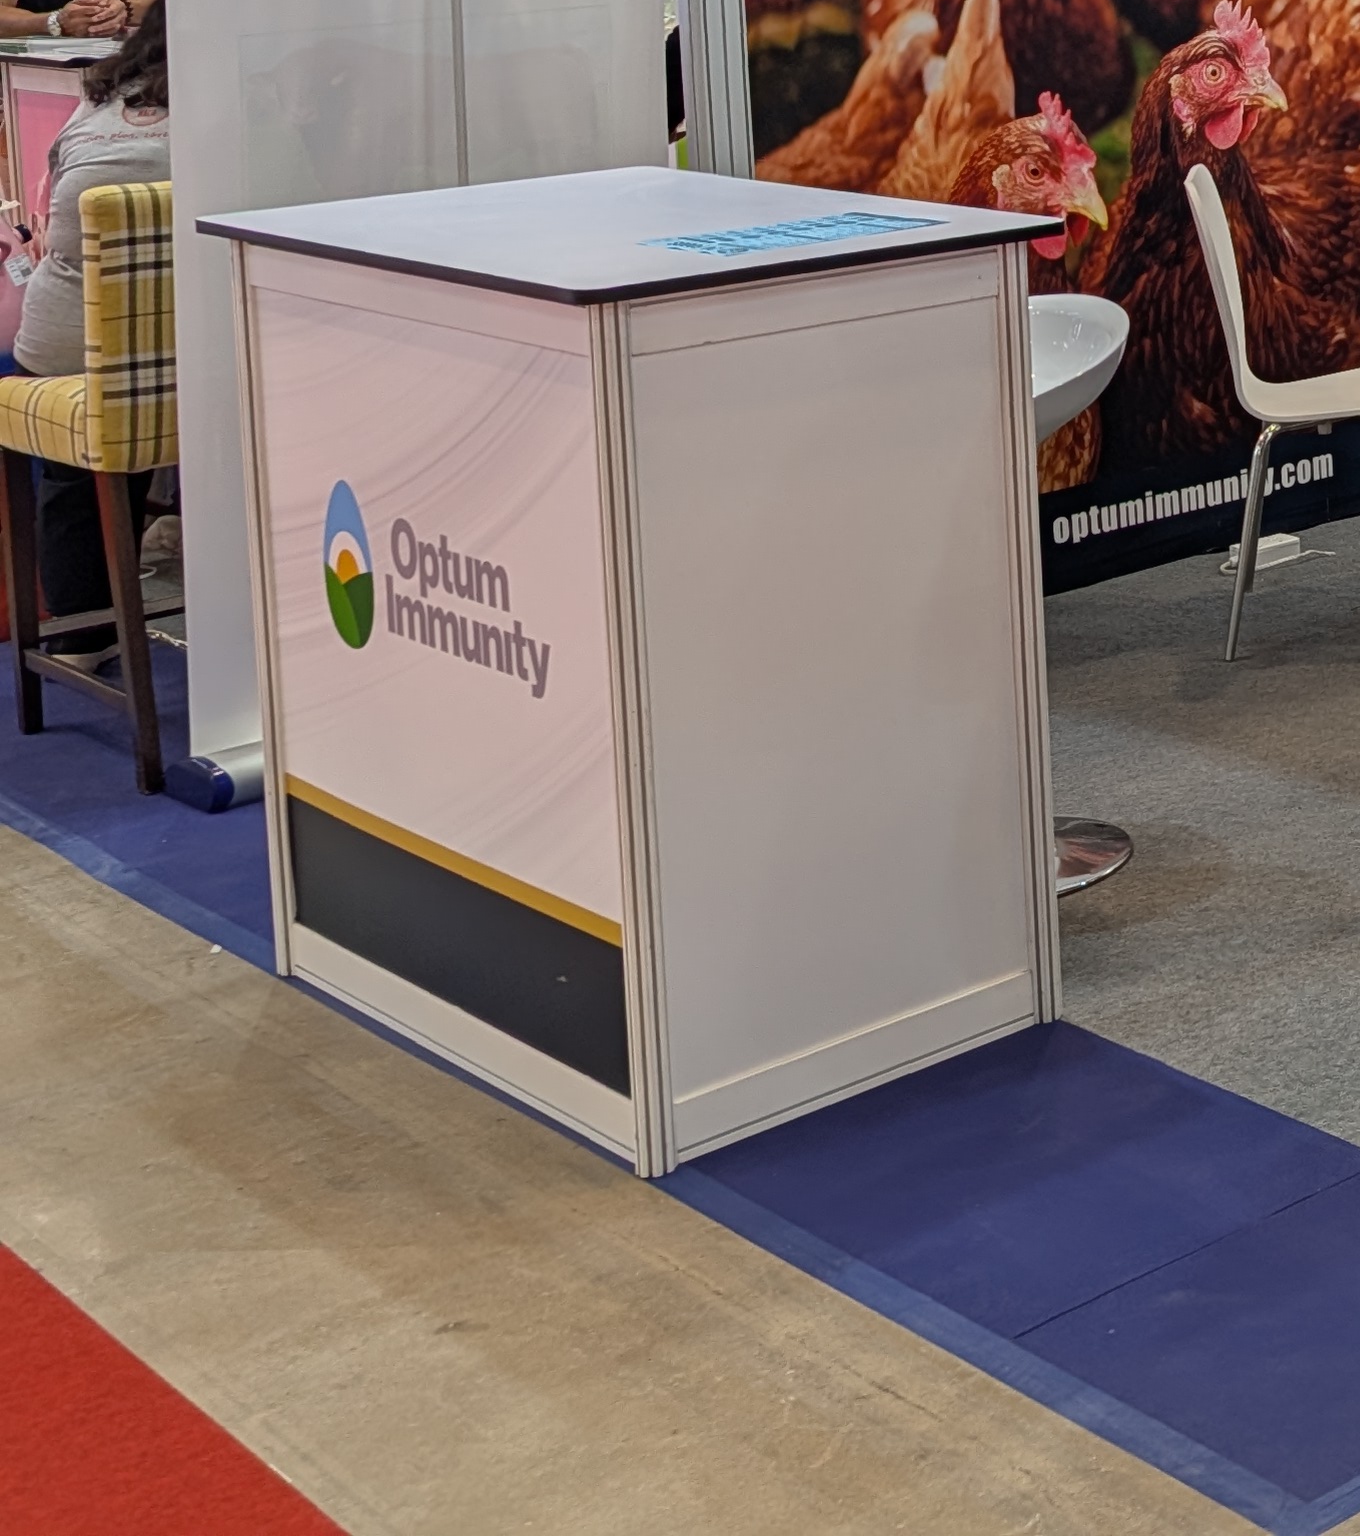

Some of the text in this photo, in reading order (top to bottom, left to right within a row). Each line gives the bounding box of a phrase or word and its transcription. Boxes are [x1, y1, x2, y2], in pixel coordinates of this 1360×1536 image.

[1053, 450, 1333, 544] optumimmuniy.com
[390, 518, 509, 611] Optum
[385, 574, 550, 700] Immunity
